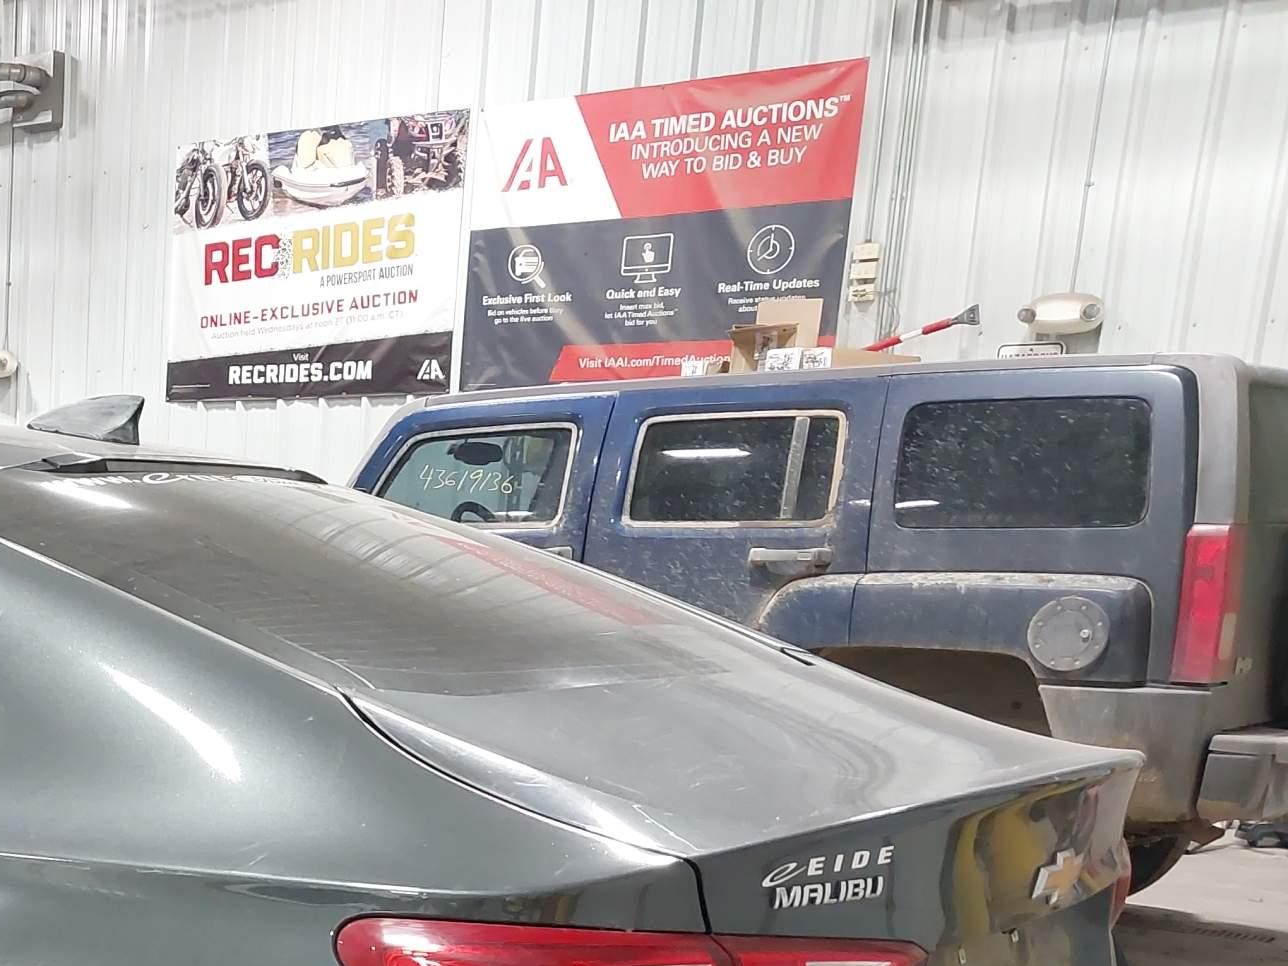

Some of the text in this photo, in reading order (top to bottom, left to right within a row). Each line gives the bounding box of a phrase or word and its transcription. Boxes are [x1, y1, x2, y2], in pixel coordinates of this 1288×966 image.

[609, 123, 647, 143] IAA
[651, 112, 716, 138] TIMED
[632, 123, 824, 161] INTRODUCING A NEW
[641, 145, 808, 179] WAY TO BID & BUY
[204, 213, 416, 286] REC RIDES
[320, 264, 414, 288] A POWERSPORT AUCTION
[718, 278, 820, 293] Real-Time Updates
[482, 291, 572, 306] Exclusive First Look
[605, 287, 682, 300] Quick and Easy
[200, 289, 419, 329] ONLINE-EXCLUSIVE AUCTION
[645, 319, 658, 327] you
[292, 353, 309, 362] Visit
[579, 357, 602, 368] Visit
[228, 360, 373, 385] RECRIDES.COM
[420, 464, 513, 494] 43619136
[773, 876, 884, 909] MALIBU
